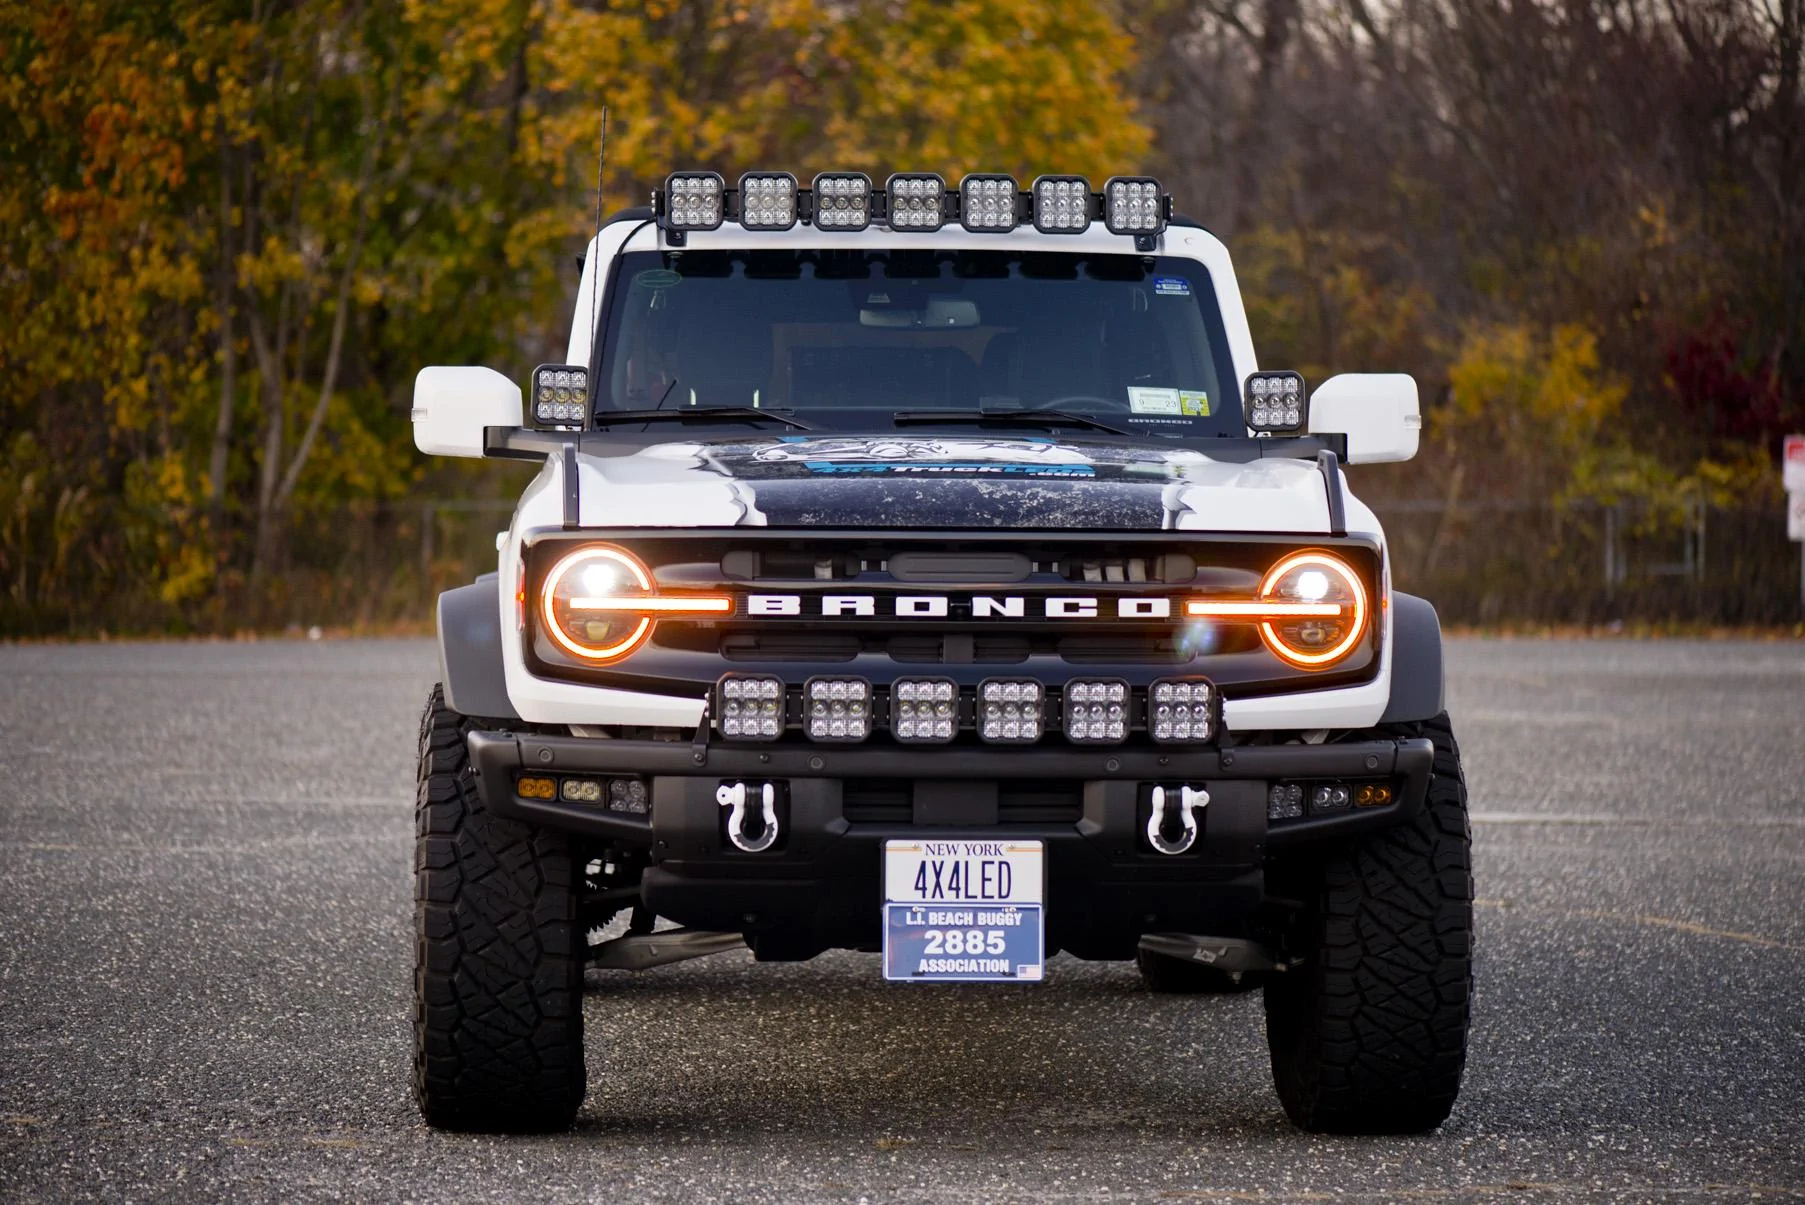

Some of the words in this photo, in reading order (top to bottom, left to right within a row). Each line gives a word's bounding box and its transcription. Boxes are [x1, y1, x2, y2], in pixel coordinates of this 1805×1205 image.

[747, 595, 1171, 618] BRONCO
[925, 843, 960, 856] NEW
[964, 843, 1004, 856] YORK
[914, 860, 1012, 899] 4X4LED
[906, 911, 926, 926] L.I.
[928, 911, 974, 926] BEACH
[977, 912, 1023, 926] BUGGY
[923, 929, 1006, 955] 2885
[918, 958, 1010, 973] ASSOCIATION
